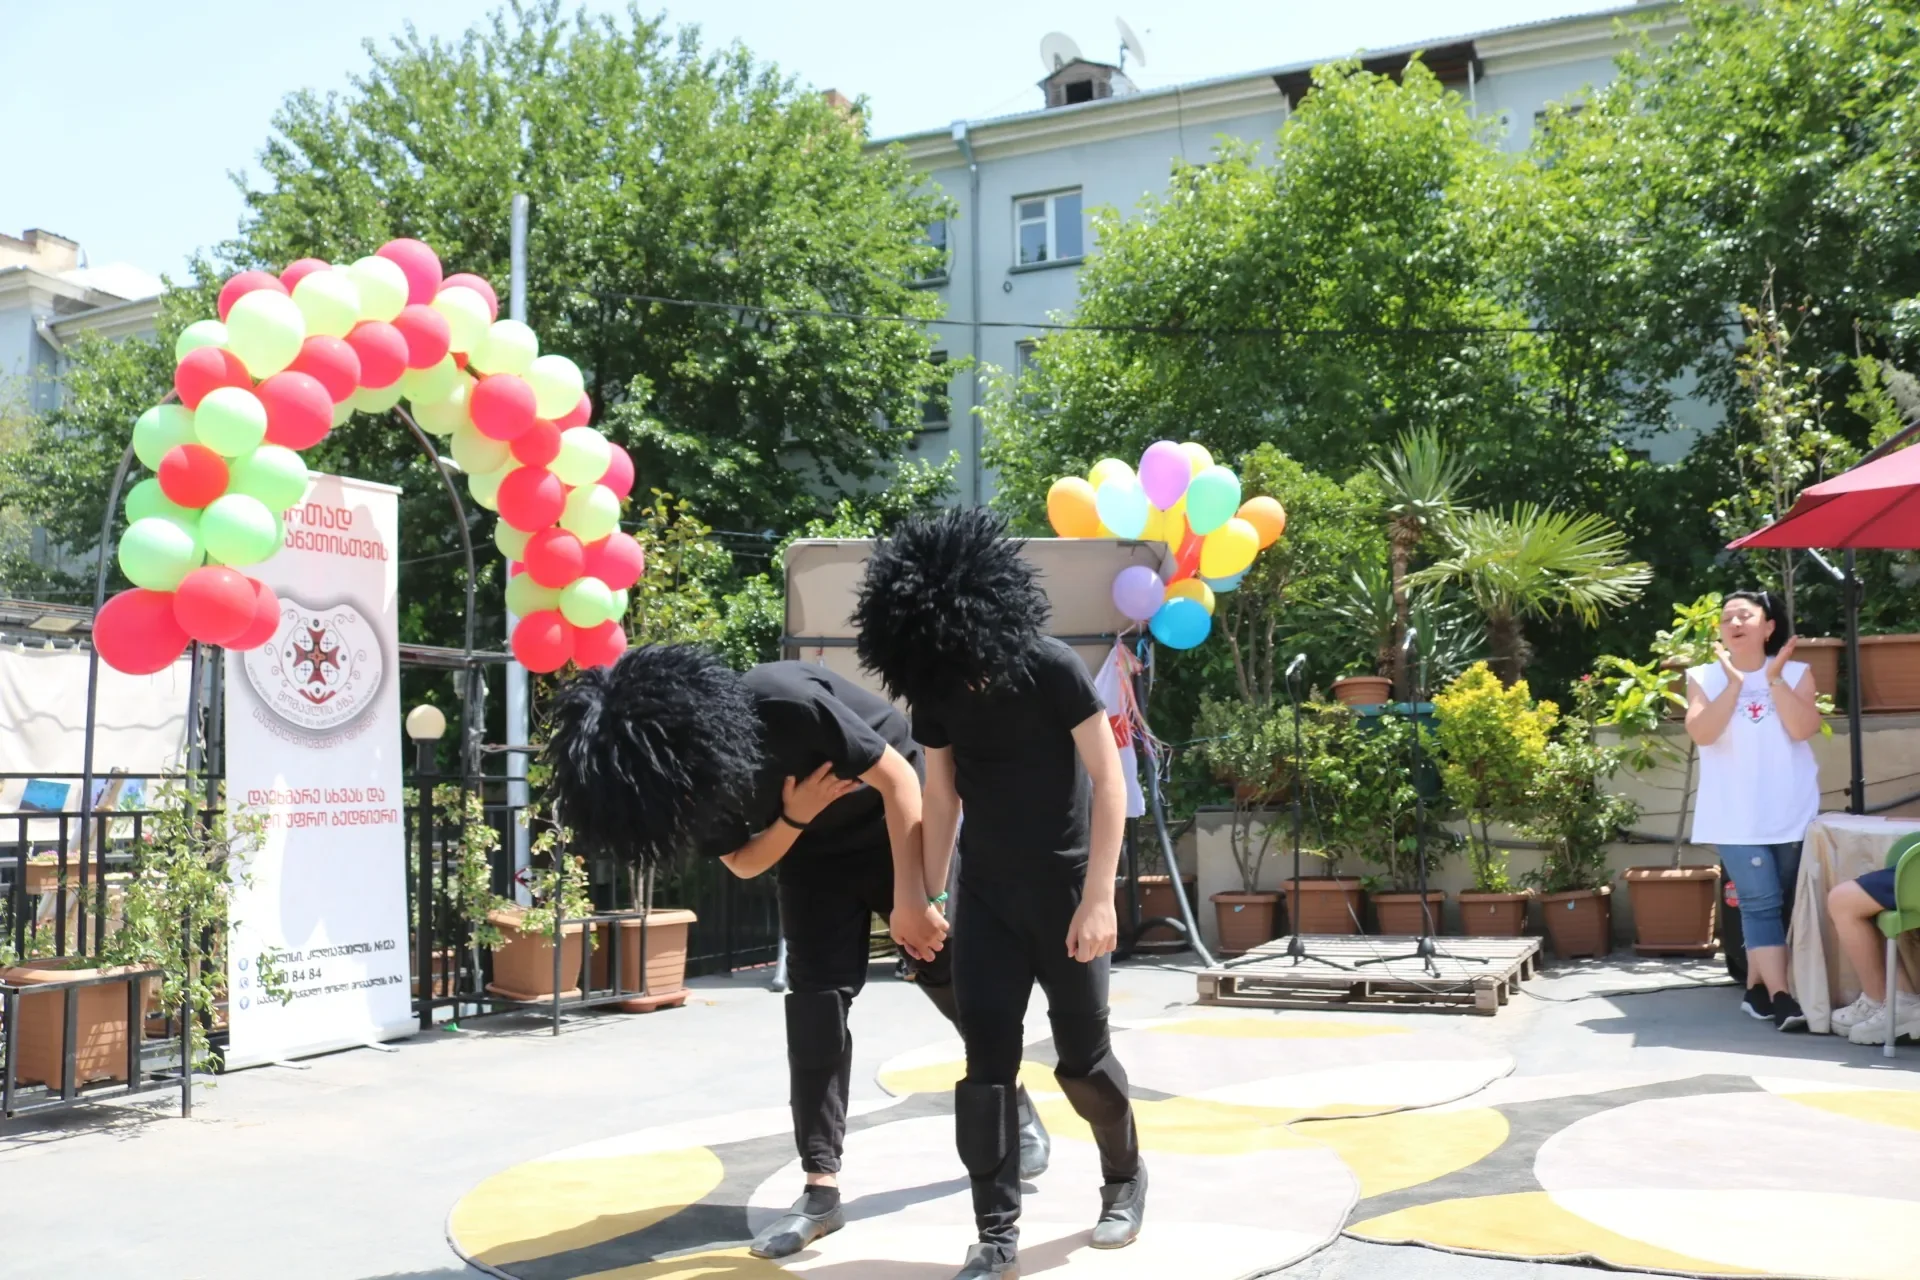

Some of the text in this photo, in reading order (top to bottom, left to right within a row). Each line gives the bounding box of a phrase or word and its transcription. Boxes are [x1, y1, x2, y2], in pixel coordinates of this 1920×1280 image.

[248, 786, 385, 806] დაეხმარე სხვას და
[286, 811, 327, 828] უფრო
[331, 808, 397, 826] ბედნიერი
[292, 969, 305, 983] 84
[309, 965, 322, 980] 84
